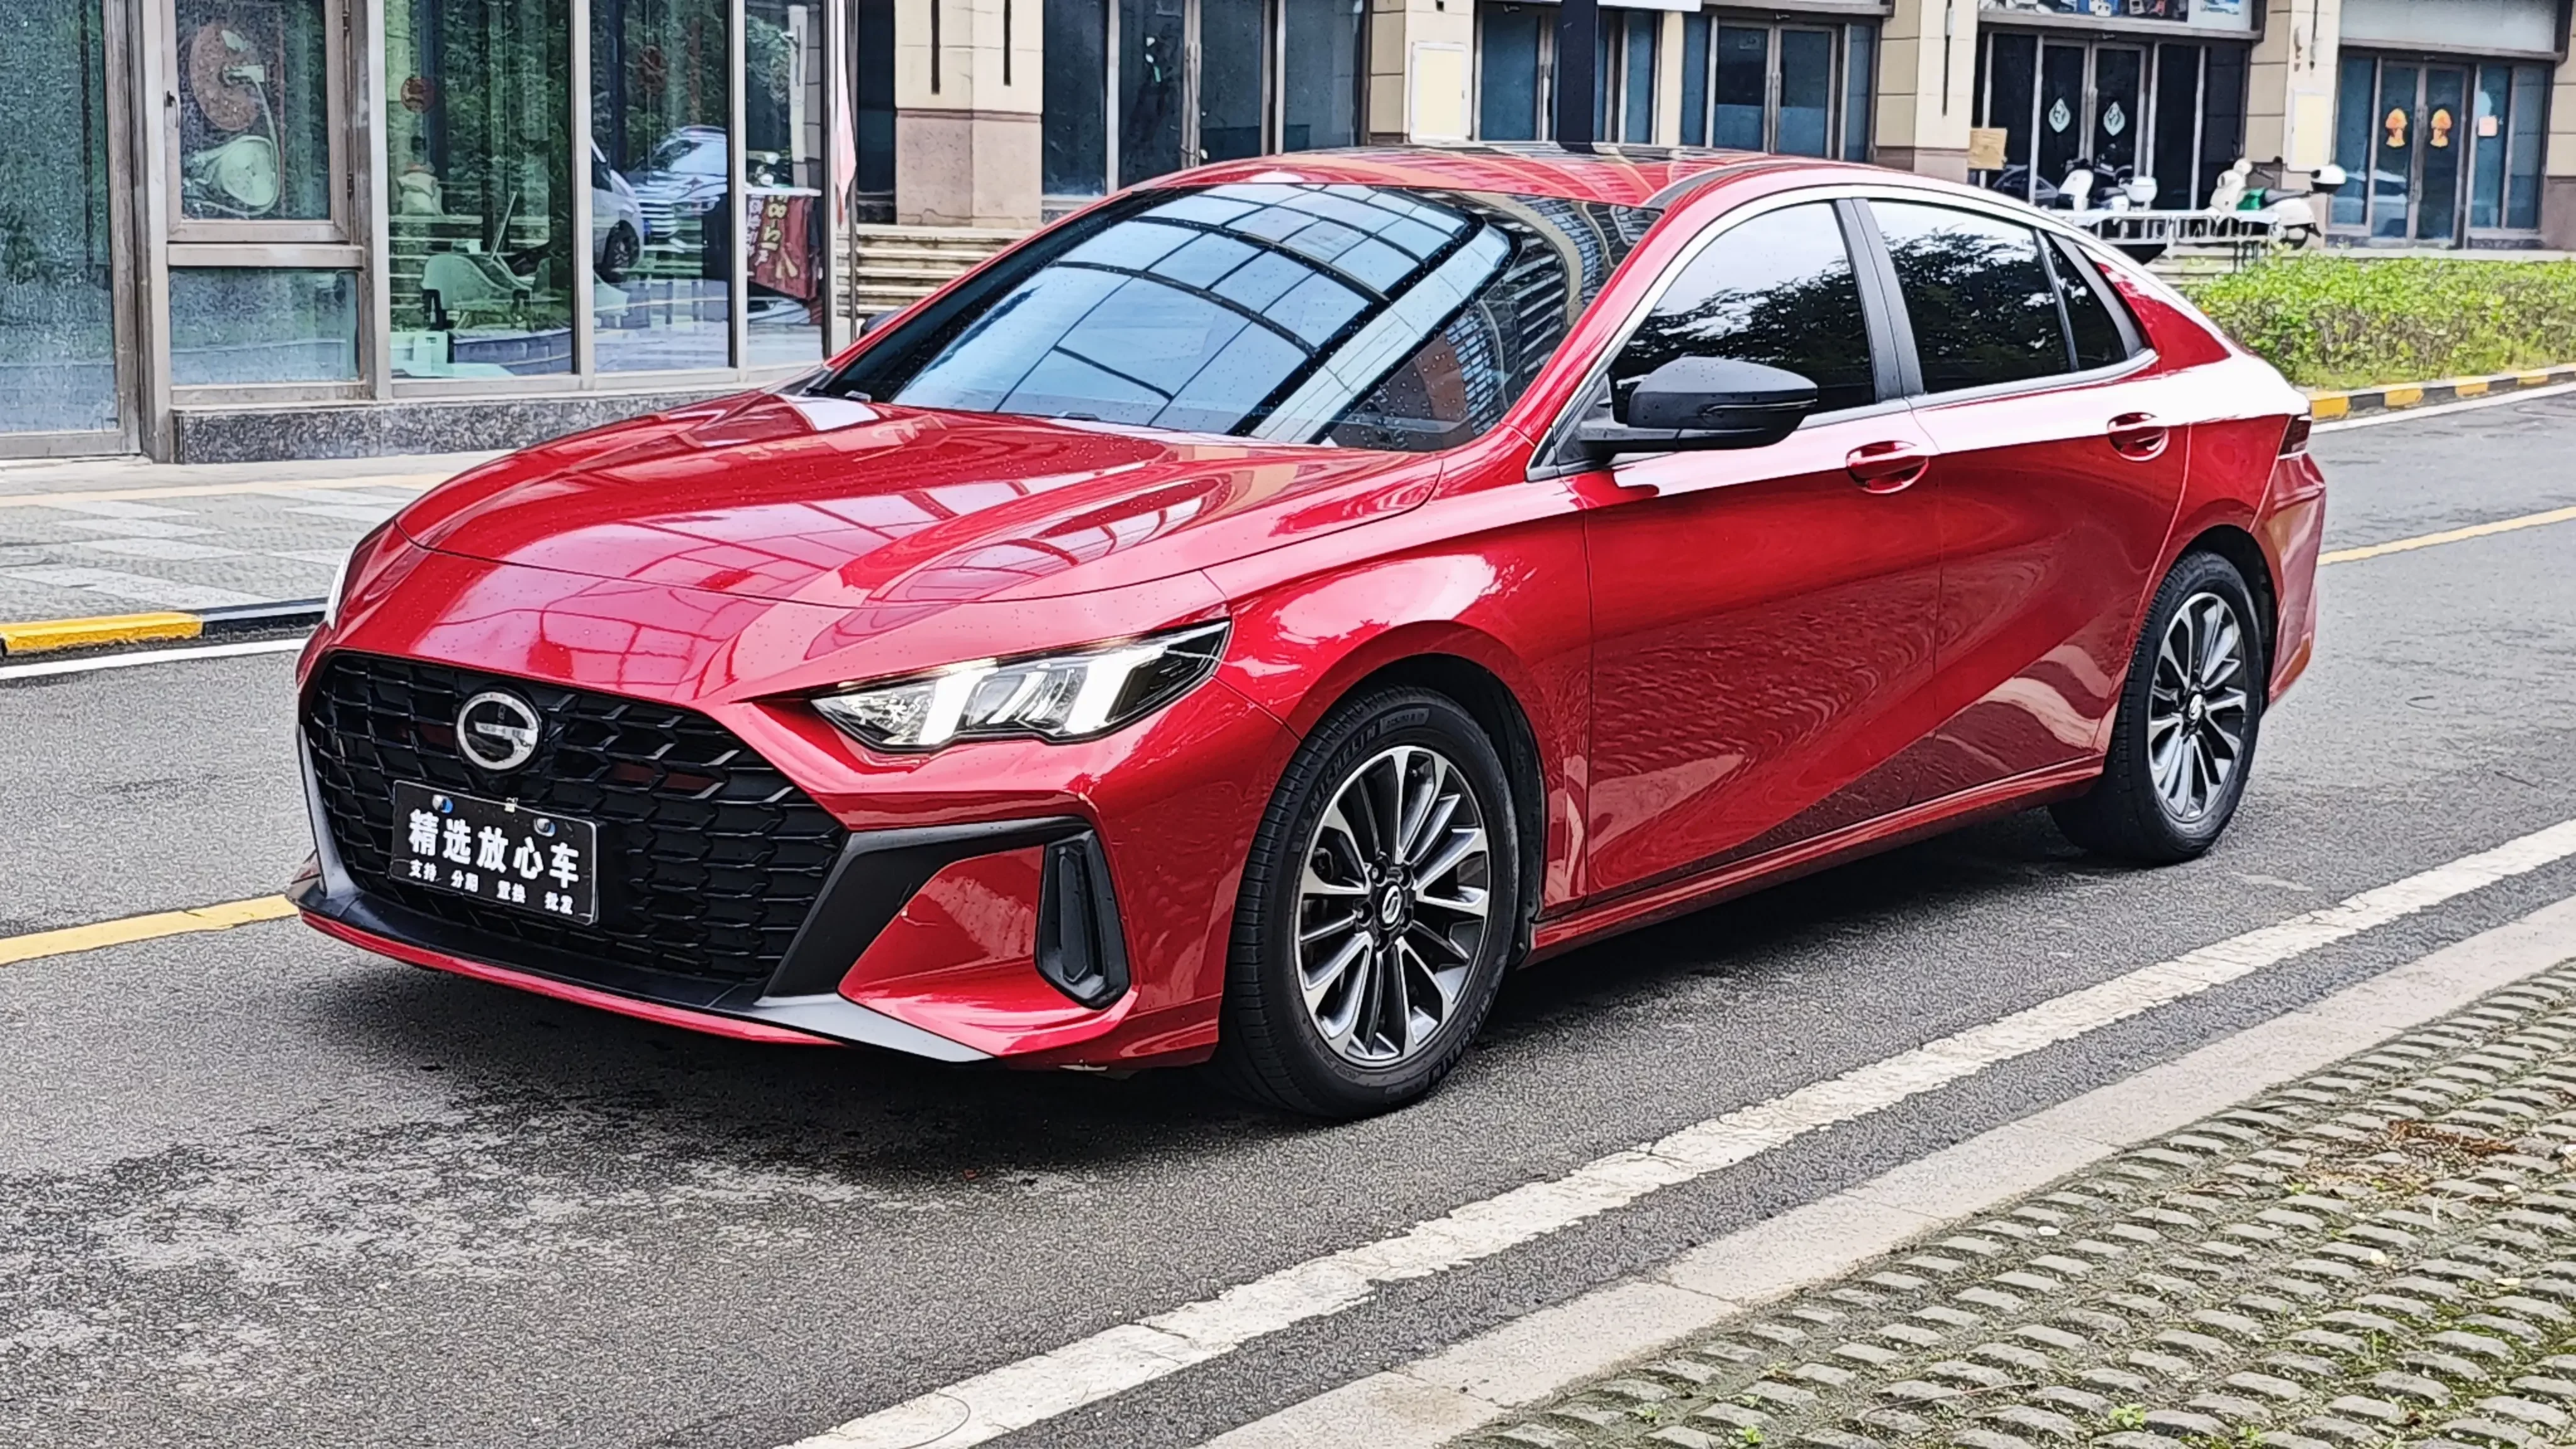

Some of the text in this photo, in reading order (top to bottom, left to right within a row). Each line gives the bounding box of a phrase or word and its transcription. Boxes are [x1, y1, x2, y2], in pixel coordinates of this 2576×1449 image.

[408, 809, 579, 889] 精选放心车
[408, 859, 436, 882] 支持
